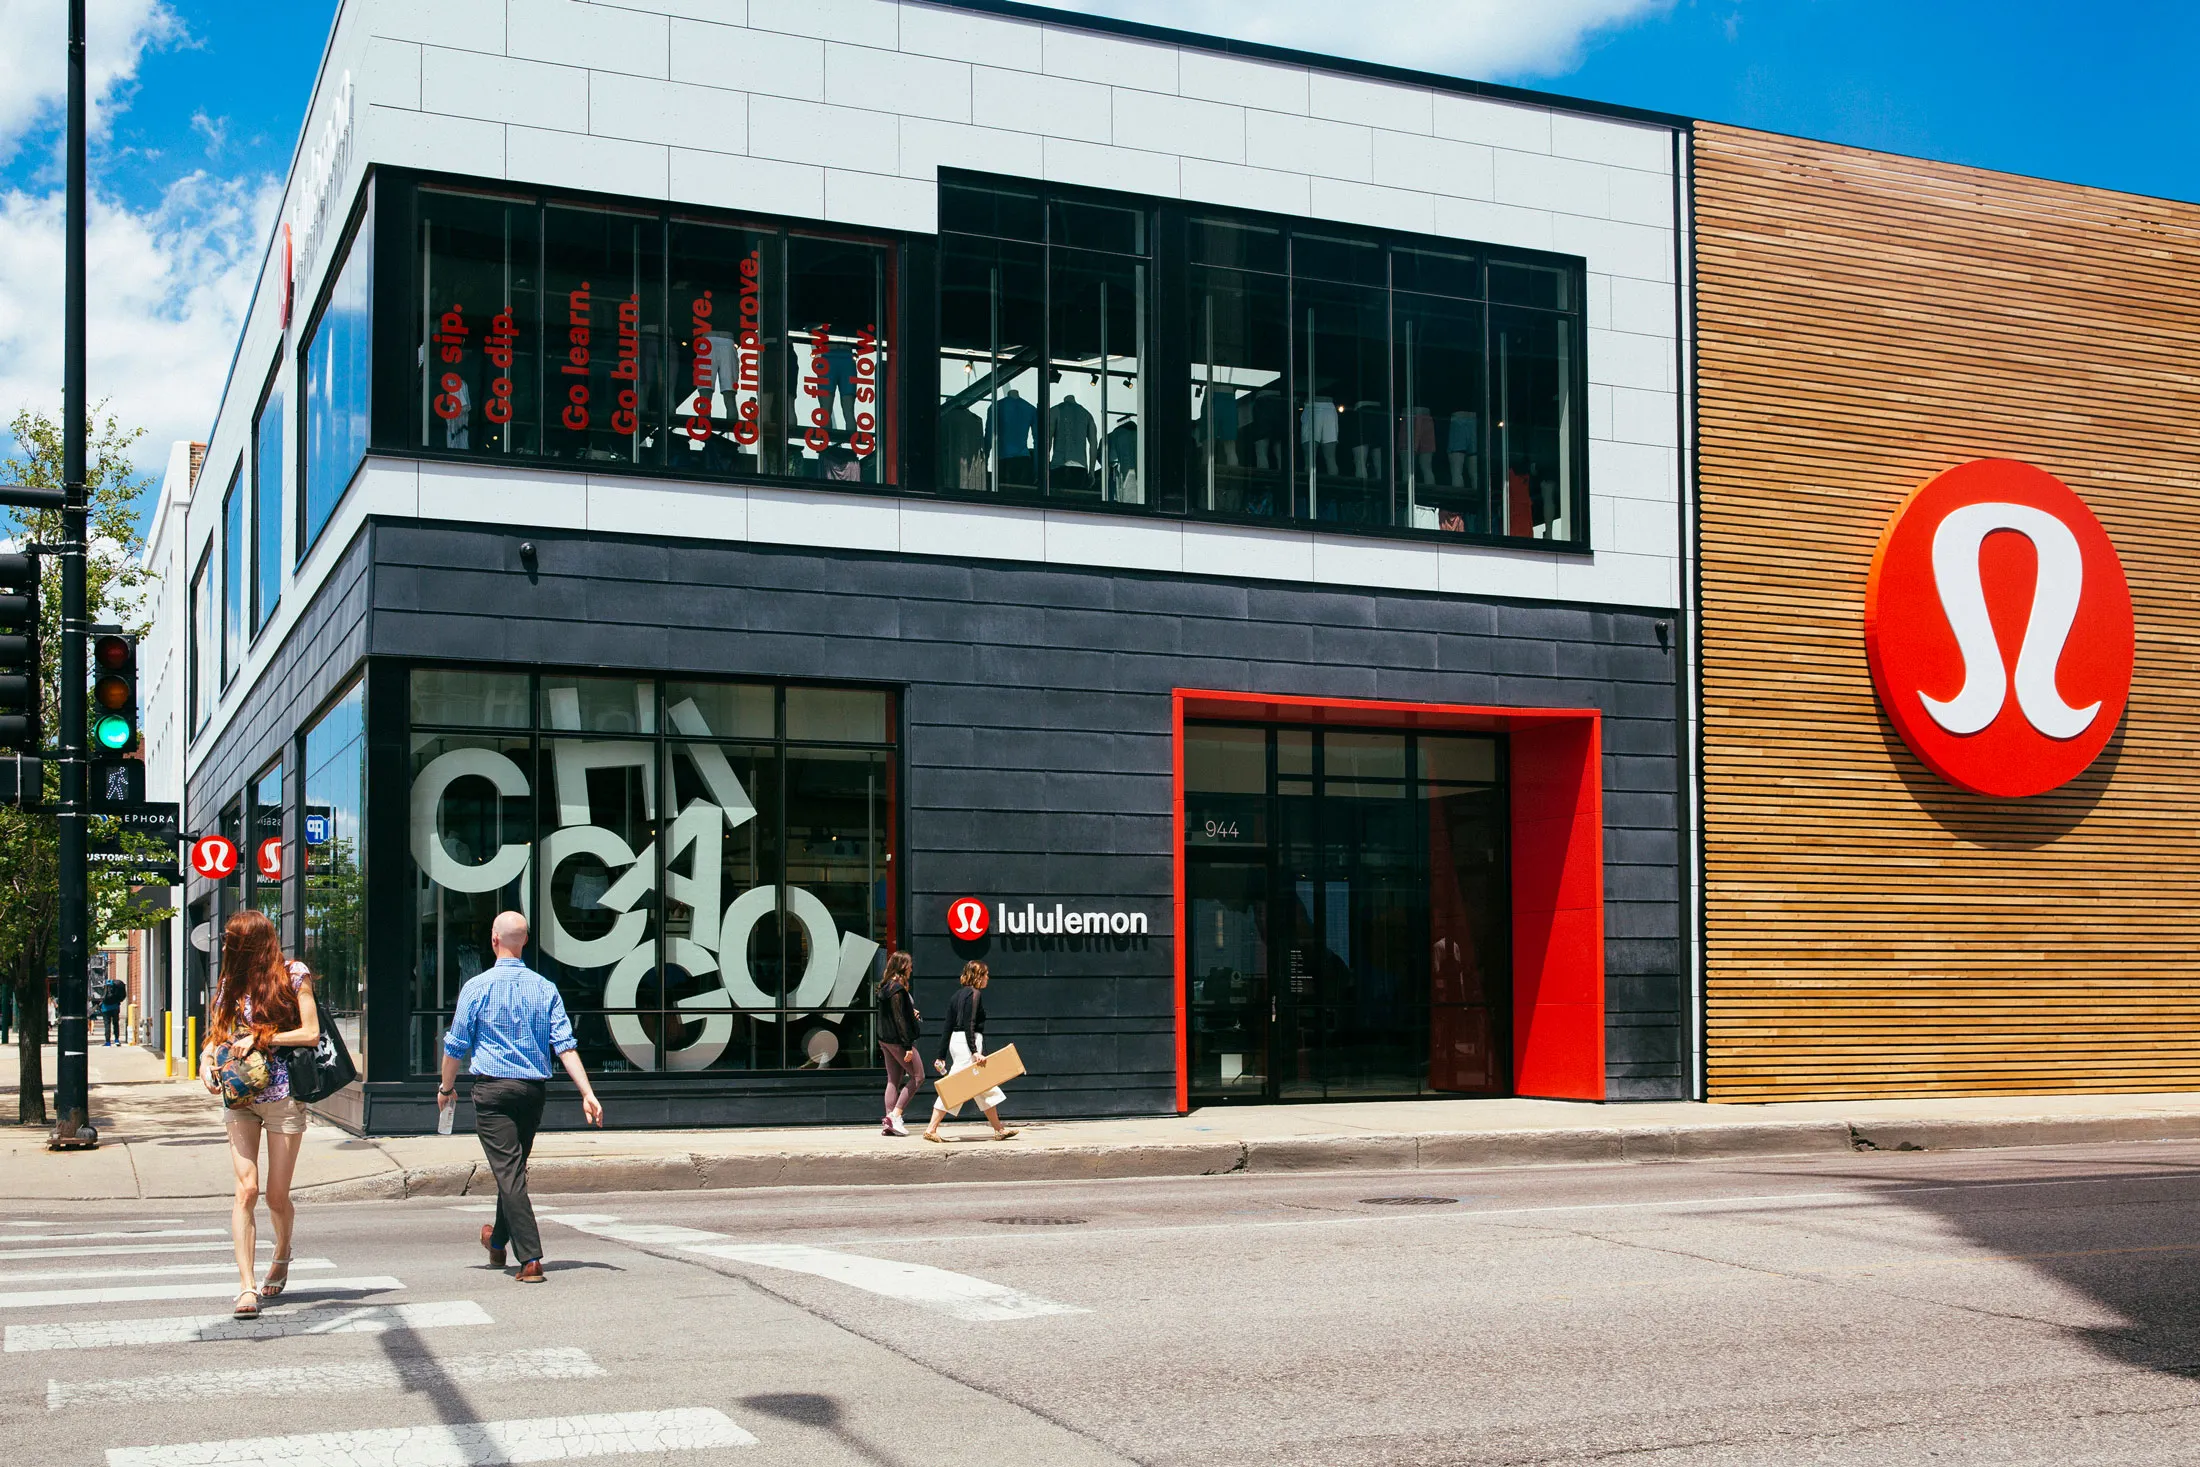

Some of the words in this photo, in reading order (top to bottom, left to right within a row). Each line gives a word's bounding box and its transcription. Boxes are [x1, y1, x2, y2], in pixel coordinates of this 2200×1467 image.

[433, 304, 469, 363] sip.
[484, 306, 519, 368] dip.
[561, 282, 590, 375] learn.
[611, 294, 639, 380] burn.
[693, 291, 712, 387] move.
[733, 251, 765, 392] improve.
[804, 323, 829, 398] flow.
[849, 324, 875, 403] slow.
[434, 373, 462, 419] Go
[485, 377, 513, 424] Go
[562, 385, 590, 430] Go
[611, 389, 639, 435] Go
[686, 396, 712, 441] Go
[733, 401, 759, 445] Go
[805, 408, 829, 451] Go
[850, 412, 875, 455] Go
[116, 814, 174, 823] EPHORA
[1205, 820, 1240, 839] 944
[998, 903, 1148, 934] lululemon
